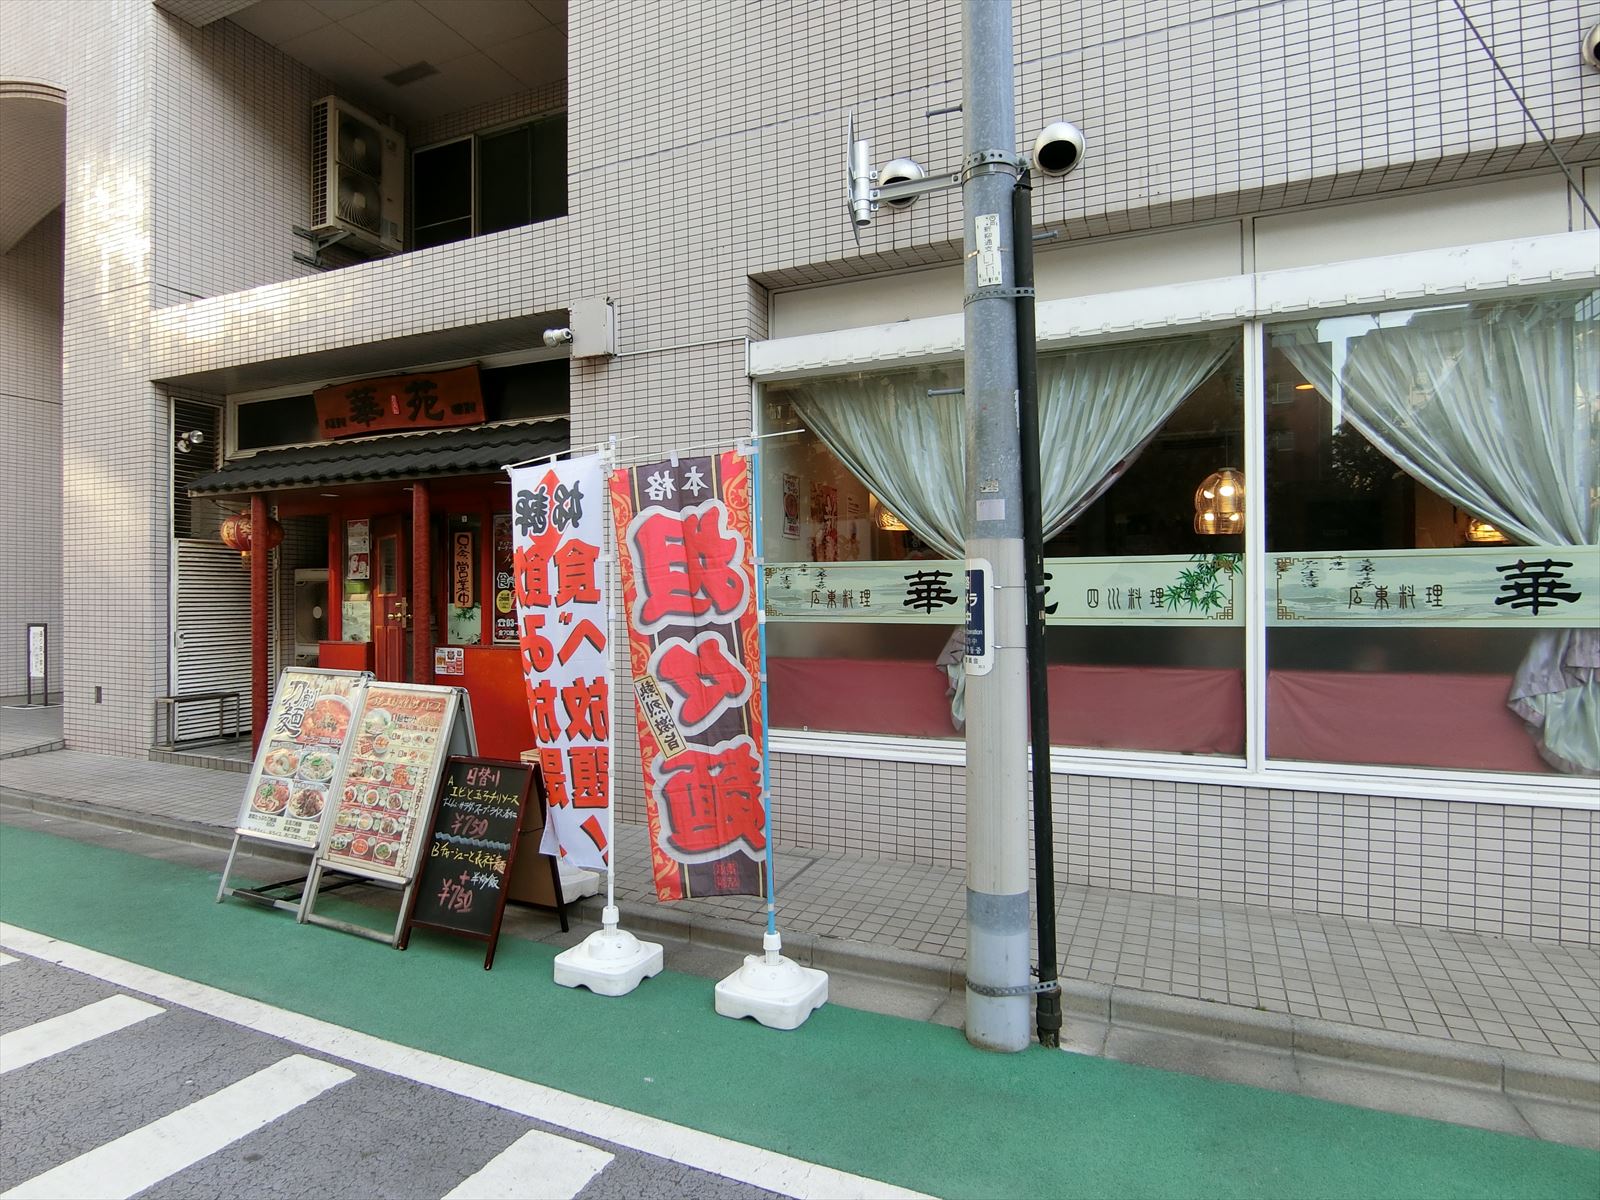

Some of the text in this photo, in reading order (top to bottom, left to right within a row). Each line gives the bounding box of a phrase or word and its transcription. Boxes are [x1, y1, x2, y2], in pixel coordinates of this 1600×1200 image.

[456, 534, 470, 606] 只今営業中
[1494, 558, 1582, 616] 華
[903, 569, 958, 615] 華
[1087, 587, 1164, 610] 四川料理
[1348, 584, 1444, 610] 広東料理
[447, 775, 454, 786] A
